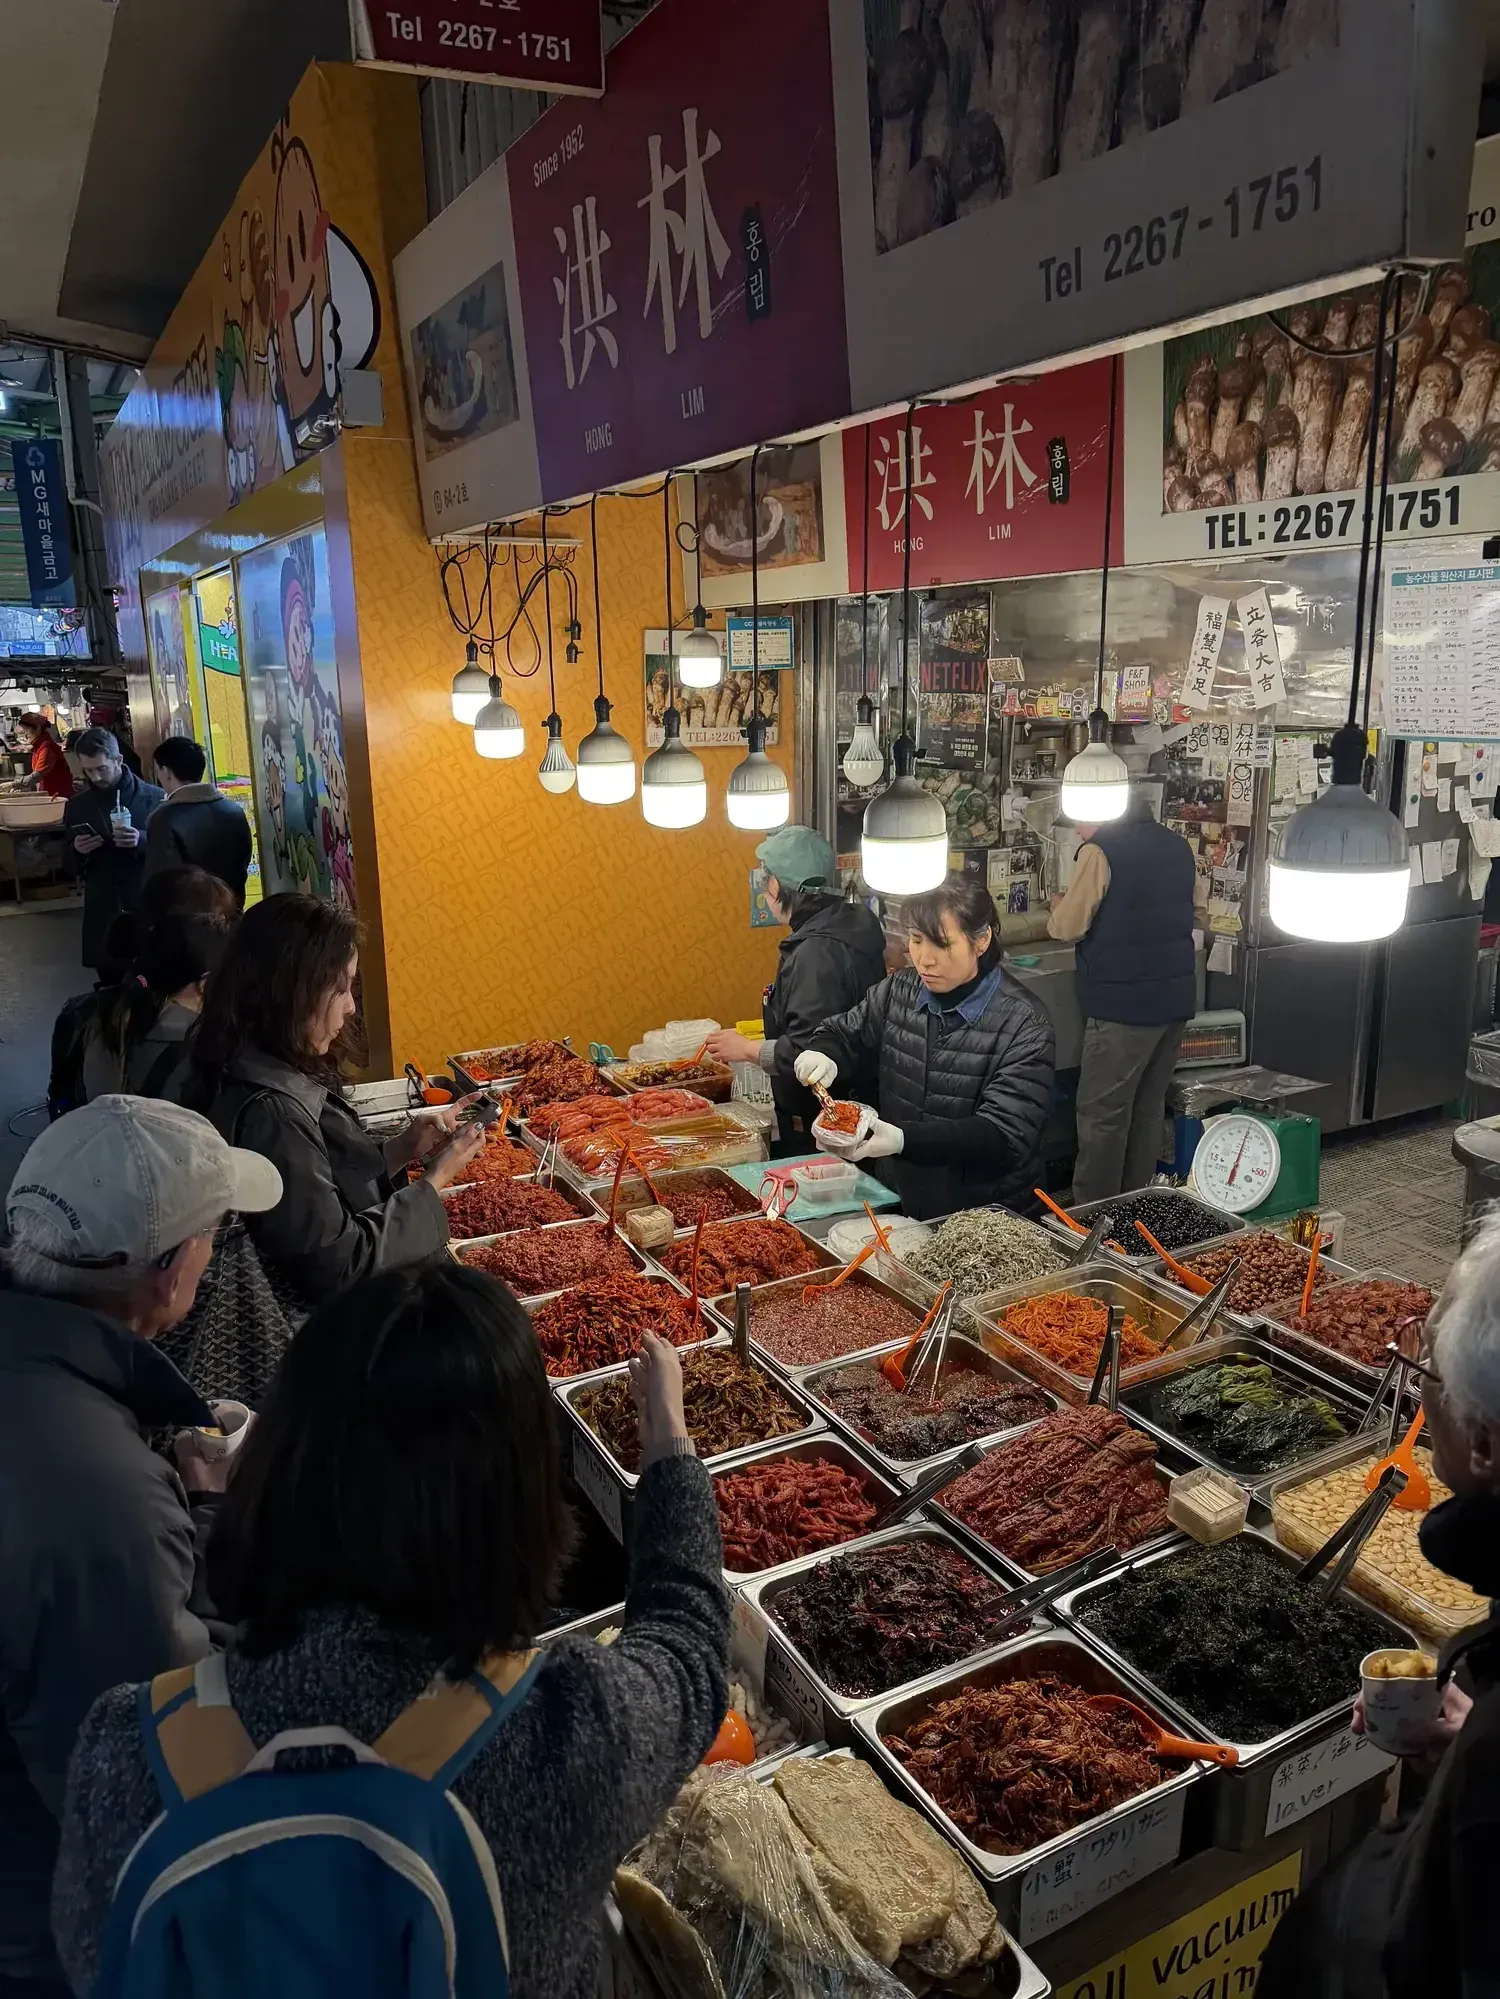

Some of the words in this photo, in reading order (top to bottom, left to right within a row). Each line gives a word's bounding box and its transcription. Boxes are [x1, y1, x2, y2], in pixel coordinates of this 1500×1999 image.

[386, 11, 423, 42] Tel
[438, 20, 572, 62] 2267-1751
[533, 155, 559, 188] Since
[559, 123, 586, 171] 1952
[552, 107, 732, 391] 洪林
[1039, 247, 1083, 302] Tel
[1103, 155, 1322, 282] 2267-1751
[745, 220, 767, 311] 홍림
[585, 423, 613, 453] HONG
[680, 387, 705, 419] LIM
[874, 403, 1038, 532] 洪林
[1051, 443, 1066, 497] 홍림
[988, 523, 1012, 541] LIM
[1205, 485, 1460, 550] TEL:22671751
[1405, 572, 1439, 584] 농수산물
[1440, 569, 1466, 582] 원산지
[1467, 567, 1495, 580] 표시판
[209, 639, 239, 661] HEA
[920, 660, 986, 692] NETFLIX
[1128, 668, 1144, 679] F&F
[1124, 680, 1146, 690] SHOP
[56, 1198, 74, 1215] BOAT
[68, 1211, 82, 1231] YARD
[1274, 1777, 1340, 1823] laver
[1152, 1887, 1295, 1986] vacuum
